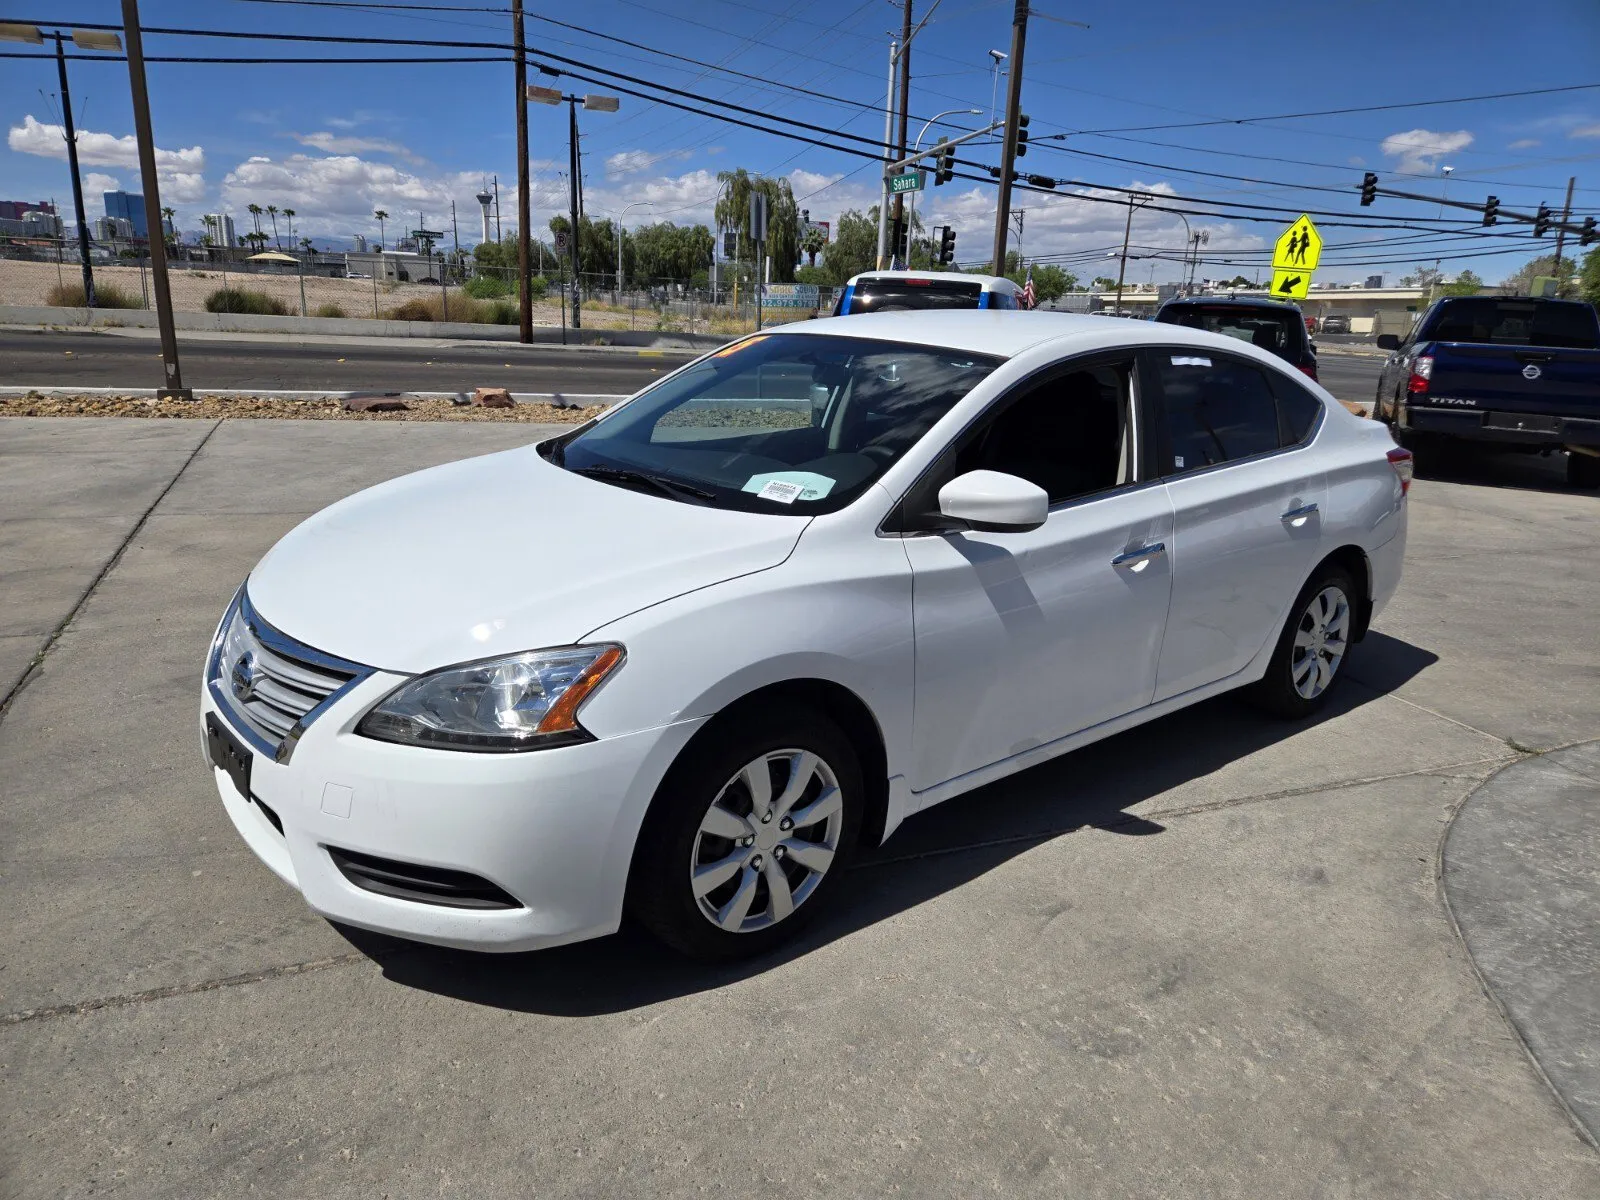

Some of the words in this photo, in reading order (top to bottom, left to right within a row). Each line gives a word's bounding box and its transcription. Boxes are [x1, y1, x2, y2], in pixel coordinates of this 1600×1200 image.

[893, 178, 915, 190] Sahara
[761, 300, 818, 308] 02.979.9799
[1429, 397, 1476, 405] TITAN
